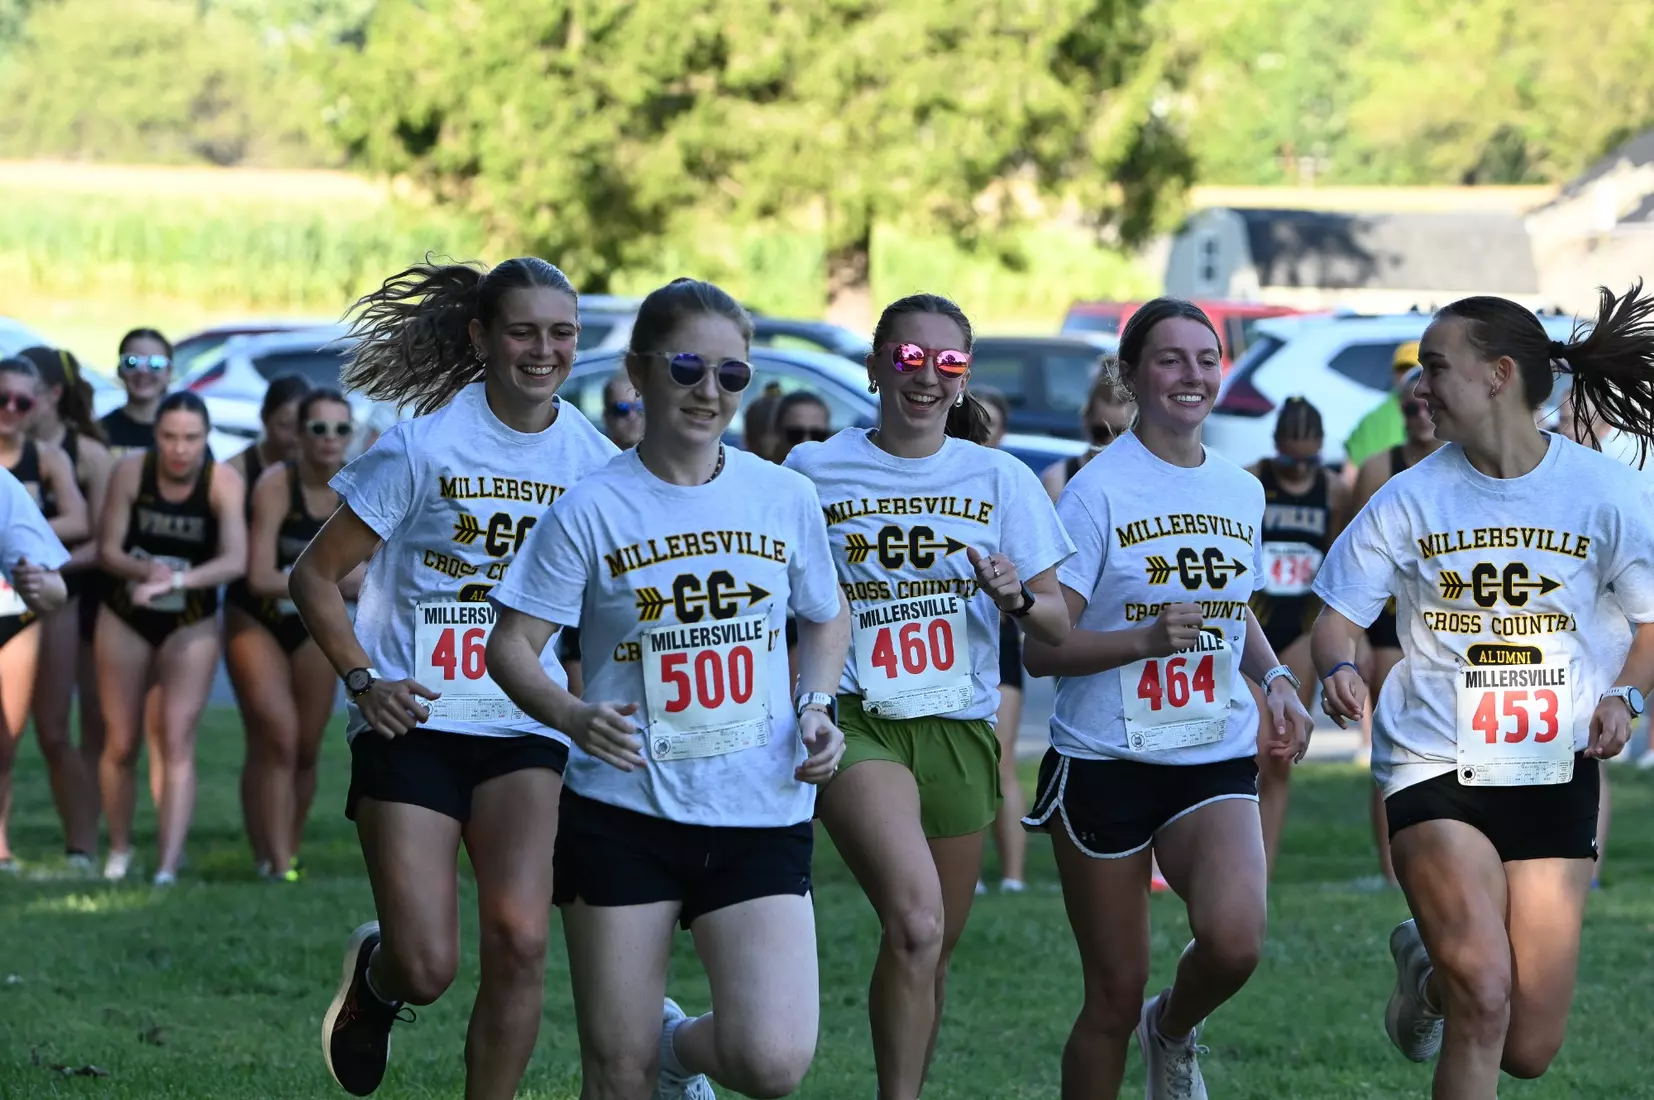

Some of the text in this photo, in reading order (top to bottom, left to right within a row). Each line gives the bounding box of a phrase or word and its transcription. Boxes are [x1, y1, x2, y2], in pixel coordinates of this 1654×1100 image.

[823, 496, 993, 526] MILLERSVILLE
[876, 525, 935, 570] CC
[1115, 513, 1254, 549] MILLERSVILLE
[1417, 527, 1591, 560] MILLERSVILLE
[604, 530, 787, 578] MILLERSVILLE
[1176, 547, 1228, 591] CC
[671, 570, 738, 624] CC
[840, 580, 890, 601] ROSS
[1471, 562, 1529, 608] CC
[424, 606, 497, 625] MILLERSV
[859, 595, 959, 629] MILLERSVILLE
[1125, 600, 1247, 622] CRO OUNT
[1423, 611, 1578, 637] CROSS COUNTRY
[431, 627, 487, 681] 46
[651, 620, 763, 652] MILLERSVILLE
[871, 618, 955, 679] 460
[1478, 650, 1532, 665] ALUMNI
[660, 645, 754, 713] 500
[1137, 654, 1215, 711] 464
[1465, 667, 1566, 689] MILLERSVILLE
[1472, 688, 1560, 744] 453
